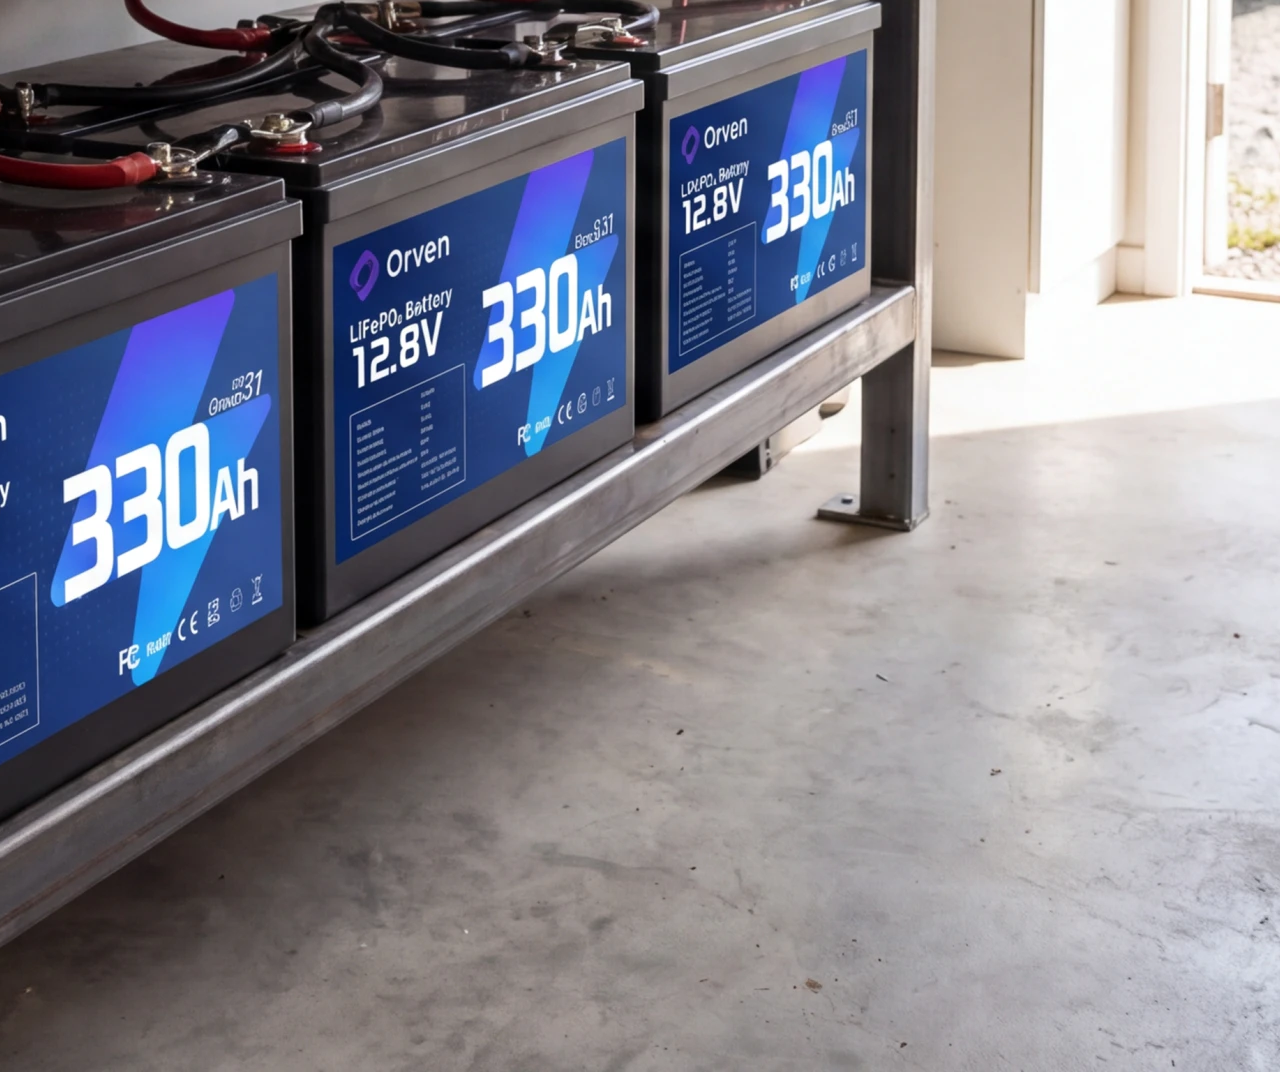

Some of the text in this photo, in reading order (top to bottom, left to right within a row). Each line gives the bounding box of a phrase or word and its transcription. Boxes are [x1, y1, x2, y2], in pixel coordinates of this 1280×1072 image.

[704, 117, 748, 149] Orven
[682, 177, 744, 235] 12.8V
[766, 139, 855, 244] 330Ah
[386, 235, 450, 278] Orven
[352, 310, 444, 389] 12.8V
[481, 253, 612, 388] 330Ah
[63, 423, 259, 604] 330Ah
